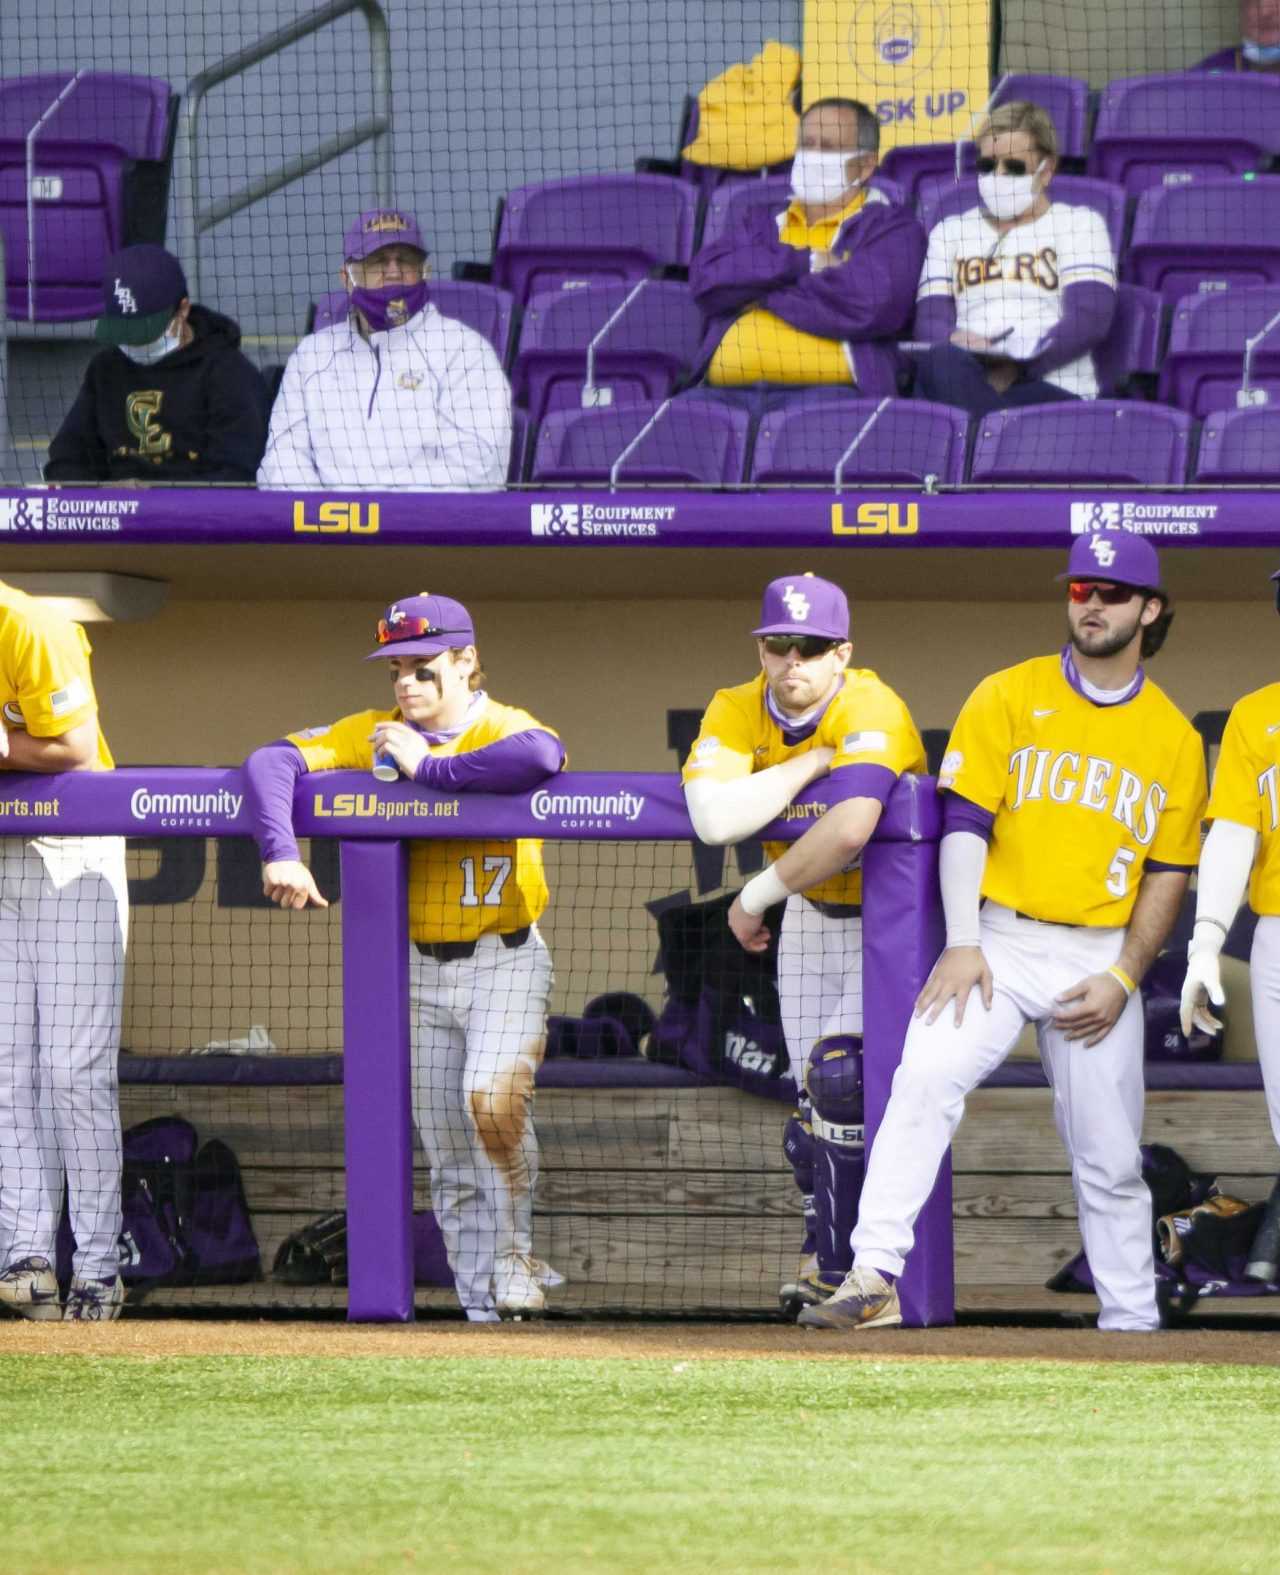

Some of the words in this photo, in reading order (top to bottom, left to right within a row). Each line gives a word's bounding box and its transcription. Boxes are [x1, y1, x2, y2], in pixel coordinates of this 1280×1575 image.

[925, 92, 966, 117] UP
[293, 500, 380, 533] LSU
[831, 502, 919, 535] LSU
[130, 788, 243, 820] Community
[313, 794, 460, 821] LSUsports.net
[530, 790, 645, 820] Community
[1008, 745, 1167, 845] TIGERS
[161, 818, 212, 827] COFFEE
[561, 820, 612, 828] COFFEE
[459, 855, 512, 906] 17
[1106, 847, 1136, 897] 5
